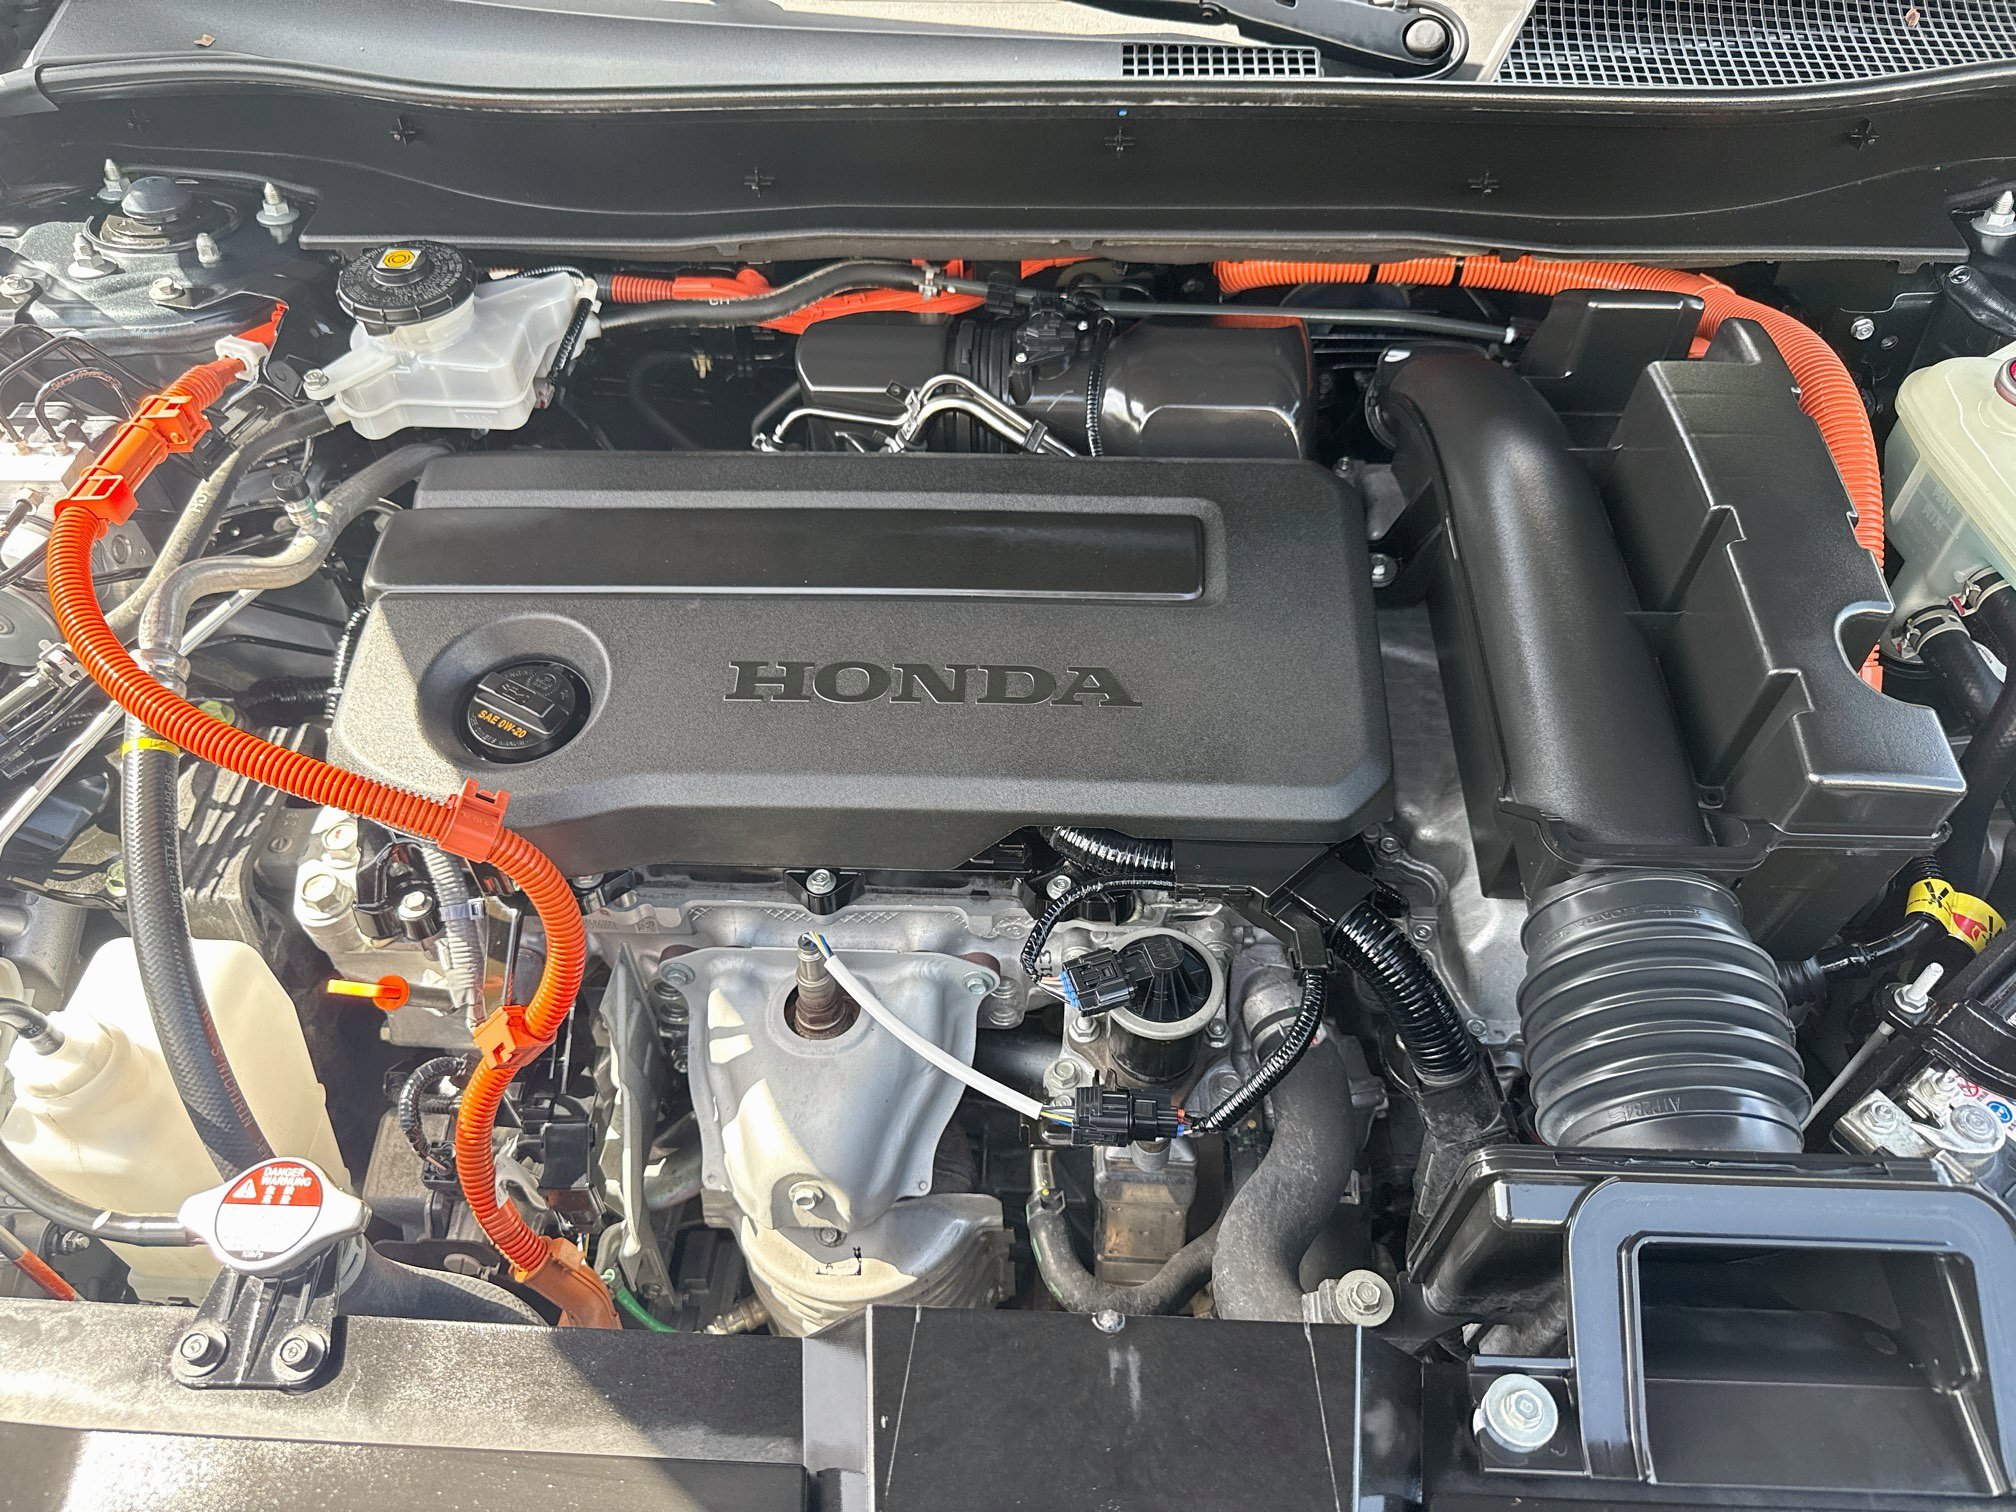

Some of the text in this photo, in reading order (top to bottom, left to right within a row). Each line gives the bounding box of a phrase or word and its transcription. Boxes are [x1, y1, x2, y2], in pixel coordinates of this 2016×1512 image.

[723, 661, 1142, 708] HONDA
[478, 709, 500, 725] SAE
[498, 719, 528, 738] 0W-20
[263, 1166, 306, 1178] DANGER
